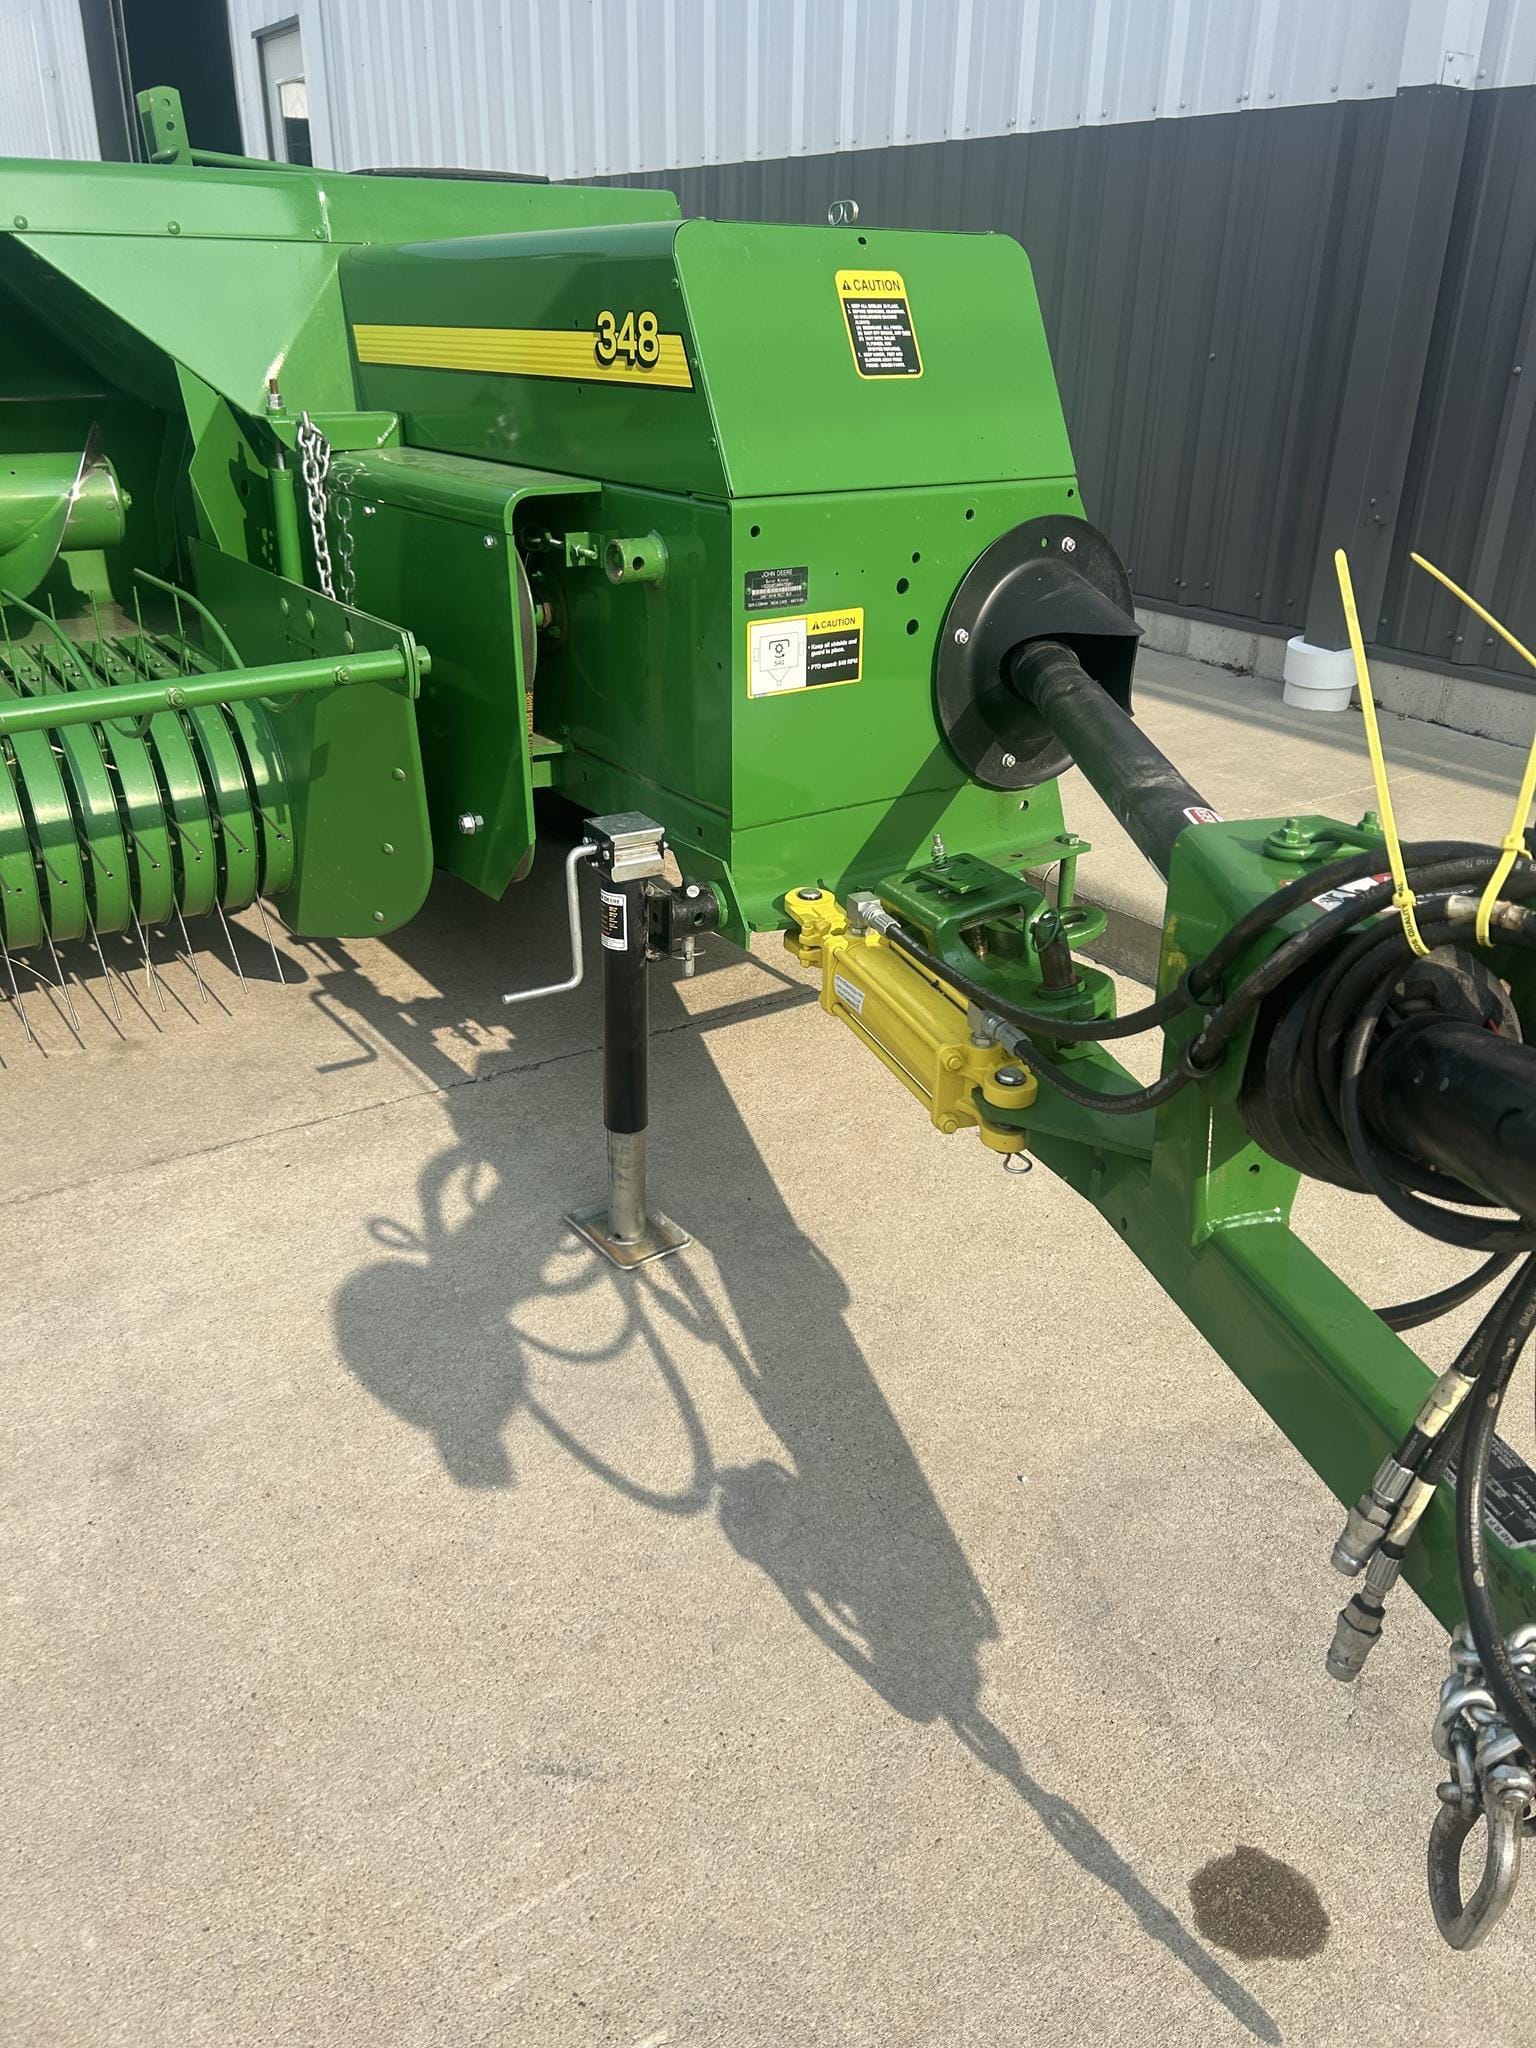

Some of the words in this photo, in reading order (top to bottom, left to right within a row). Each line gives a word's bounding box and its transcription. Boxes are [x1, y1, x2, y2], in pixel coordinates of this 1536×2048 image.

[853, 279, 901, 292] CAUTION
[596, 309, 660, 366] 348
[761, 570, 776, 578] JOHN
[776, 568, 793, 577] DEERE
[820, 617, 856, 629] CAUTION
[774, 659, 785, 667] 540
[810, 663, 822, 671] PTO
